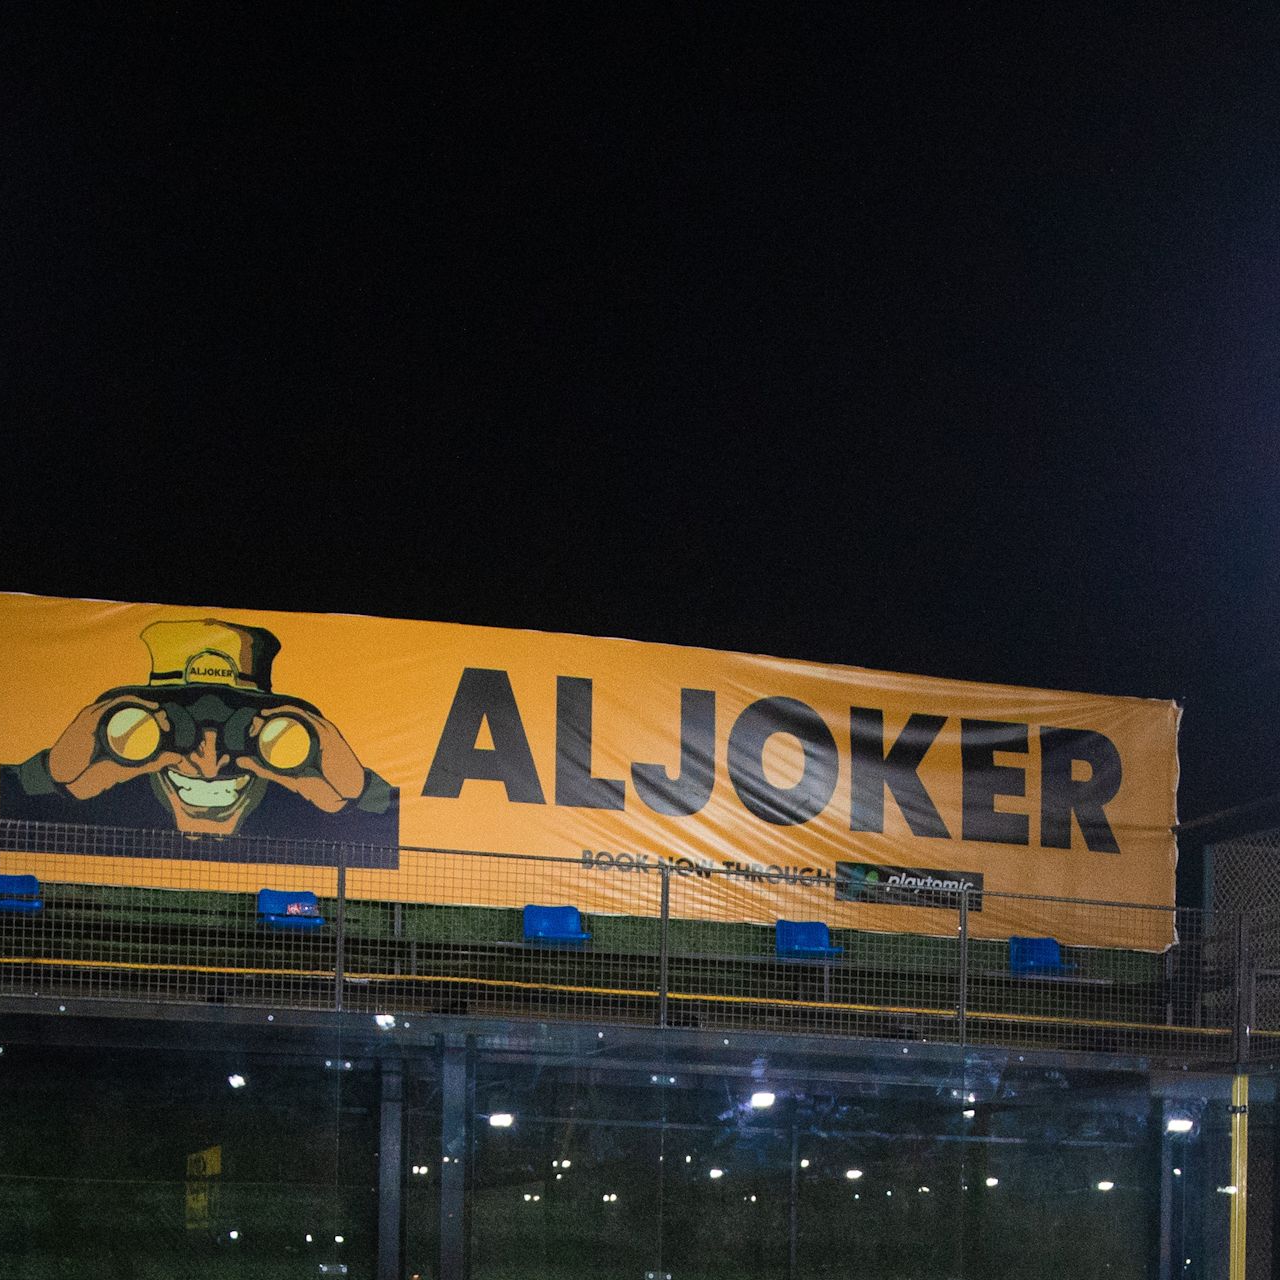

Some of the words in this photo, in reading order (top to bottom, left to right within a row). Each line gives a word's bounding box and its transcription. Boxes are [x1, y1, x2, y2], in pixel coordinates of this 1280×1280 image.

[190, 666, 233, 677] ALJOKER
[422, 667, 1123, 854] ALJOKER
[582, 850, 649, 874] BOOK
[658, 855, 713, 878] NOW
[723, 860, 831, 888] THROUGH
[885, 872, 975, 894] playtomic
